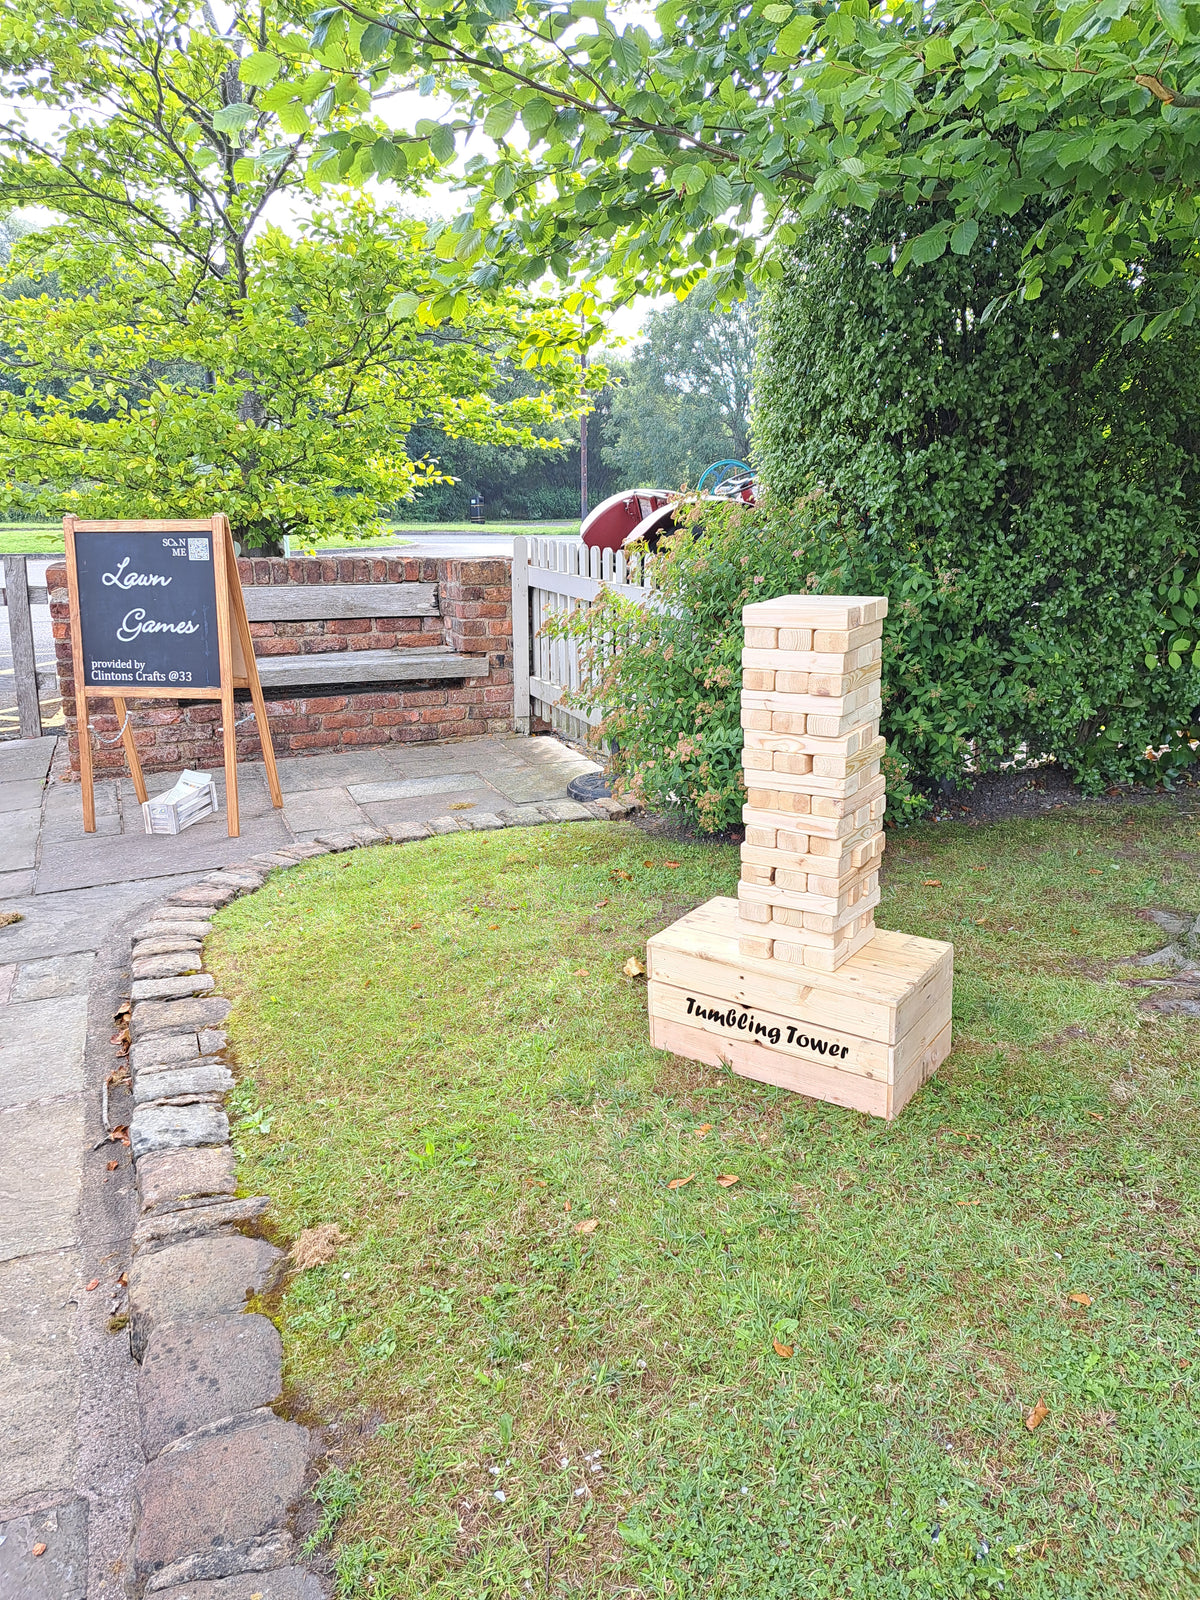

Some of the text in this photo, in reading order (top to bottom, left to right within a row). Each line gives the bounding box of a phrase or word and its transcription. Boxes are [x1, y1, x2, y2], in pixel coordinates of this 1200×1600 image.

[172, 548, 187, 557] ME
[102, 556, 172, 590] Lawn
[116, 608, 200, 642] Games
[91, 659, 146, 671] provided by
[91, 670, 192, 682] Clintons Crafts @33
[686, 997, 849, 1059] Tumbling Tower
